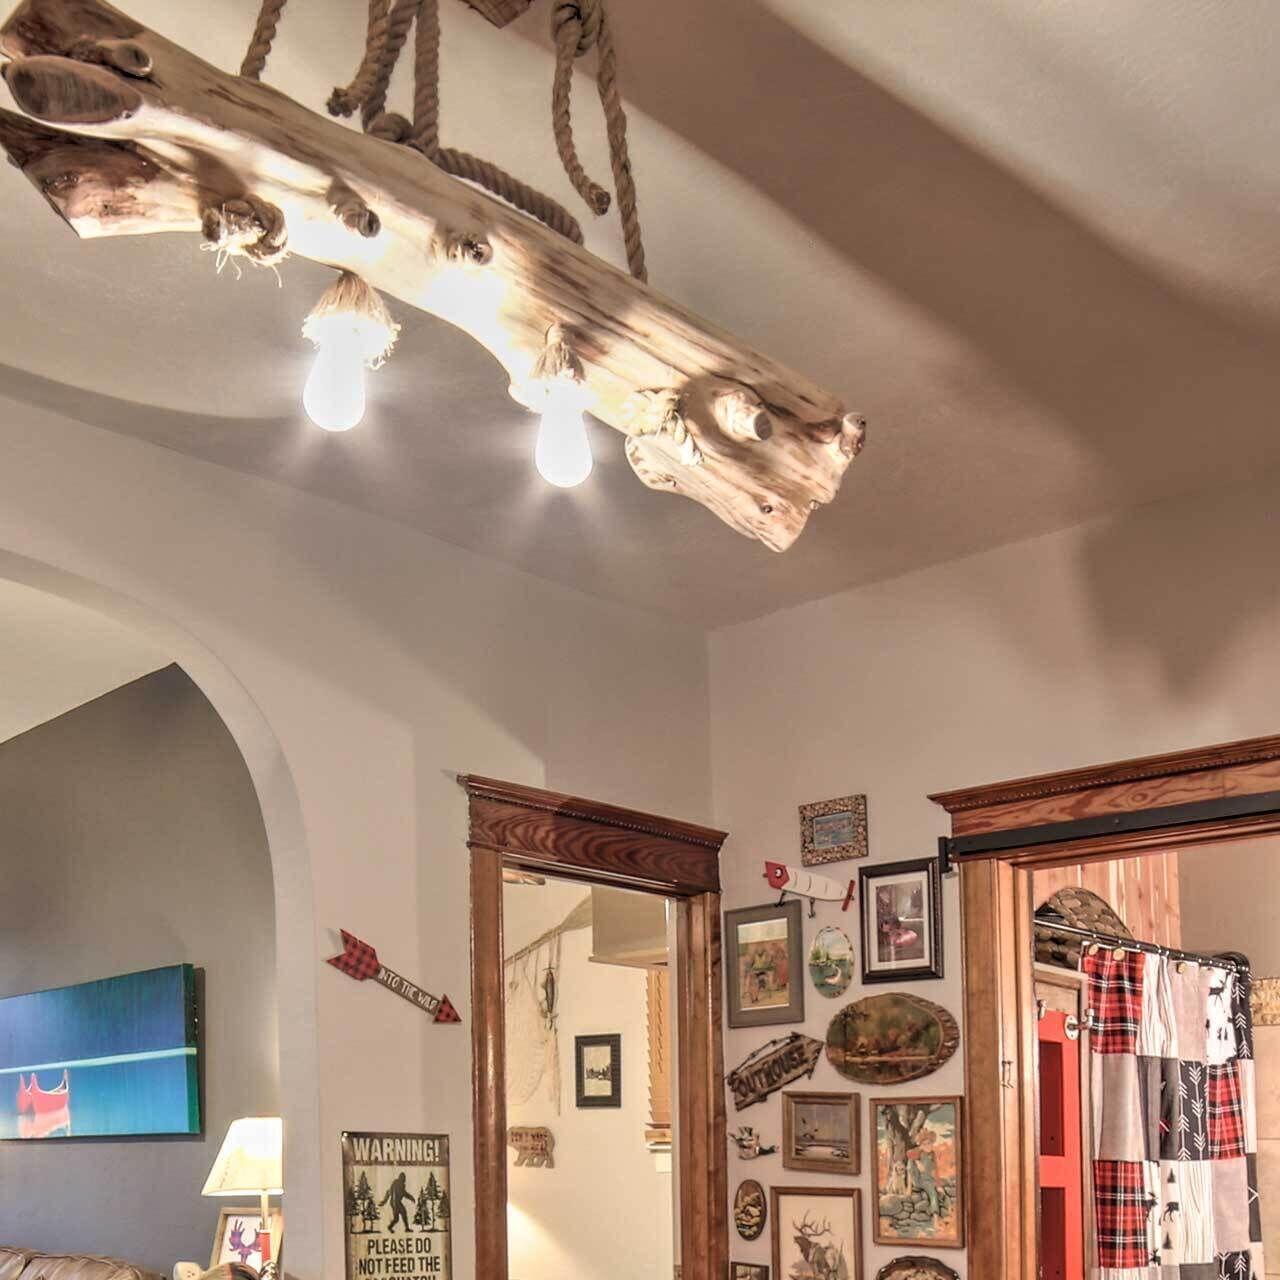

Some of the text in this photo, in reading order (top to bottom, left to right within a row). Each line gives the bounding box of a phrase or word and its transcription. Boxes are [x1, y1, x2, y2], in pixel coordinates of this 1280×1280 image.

[378, 967, 400, 988] INTO
[401, 980, 418, 999] THE
[735, 1043, 808, 1098] OUTHOUSE
[353, 1137, 440, 1162] WARNING!
[367, 1237, 432, 1255] PLEASE DO
[359, 1256, 441, 1275] NOT FEED THE
